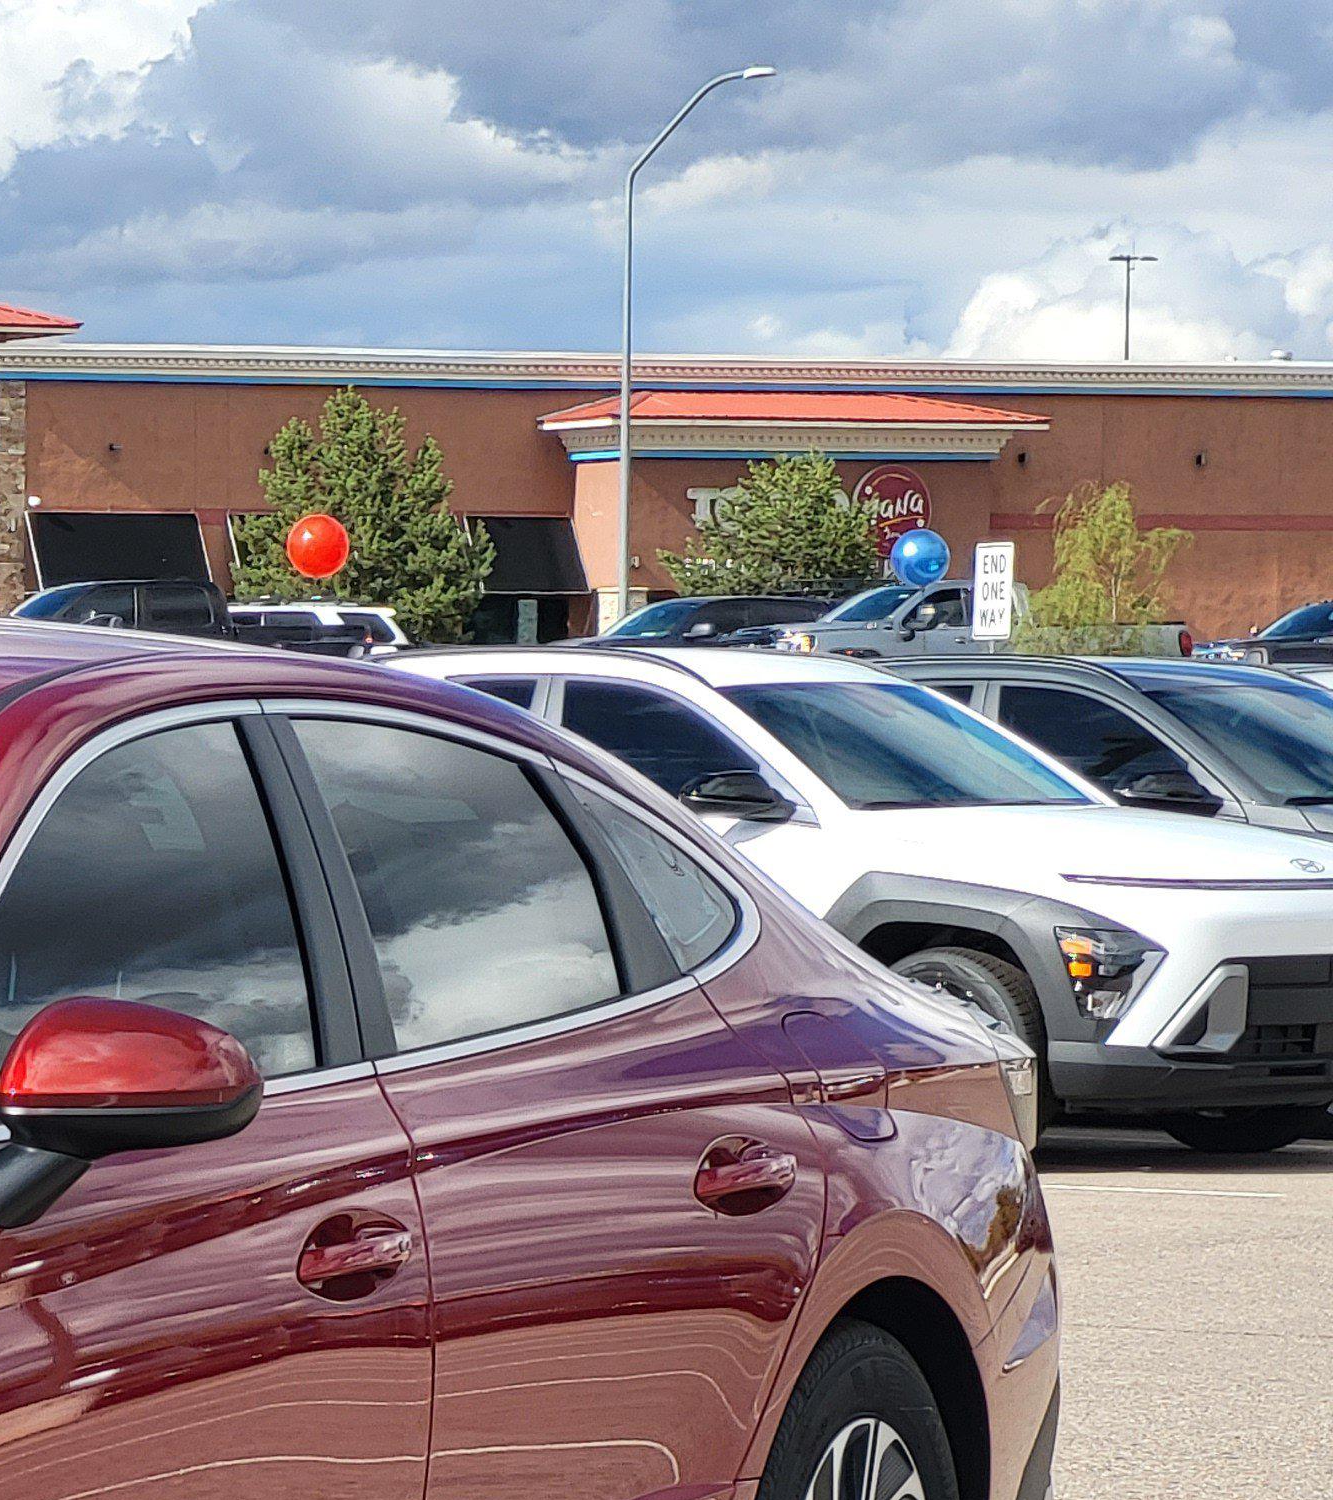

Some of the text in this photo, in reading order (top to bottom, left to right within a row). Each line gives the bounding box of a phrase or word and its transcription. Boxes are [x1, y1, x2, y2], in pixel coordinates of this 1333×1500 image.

[983, 554, 1007, 574] END
[982, 581, 1005, 601] ONE
[979, 608, 1005, 628] WAY
